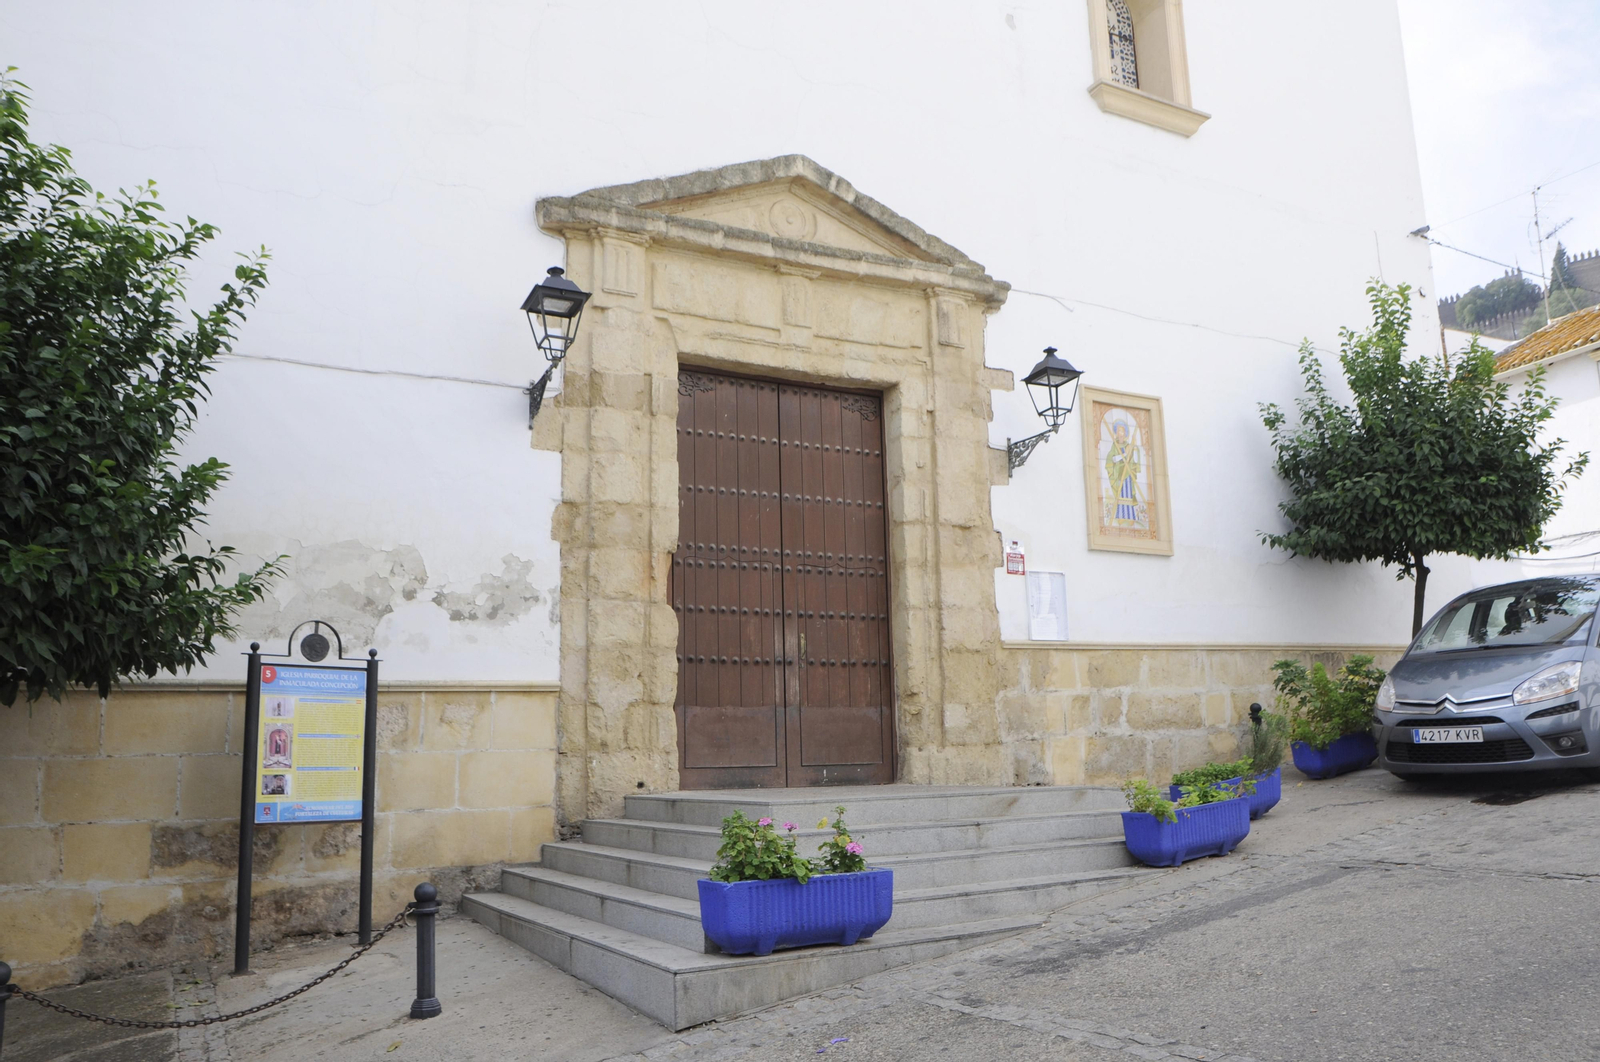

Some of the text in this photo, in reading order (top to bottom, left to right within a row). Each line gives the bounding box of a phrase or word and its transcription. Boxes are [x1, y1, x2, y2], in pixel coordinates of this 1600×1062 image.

[304, 672, 340, 680] PARROQUIAL
[1421, 729, 1480, 741] 4217 KVR
